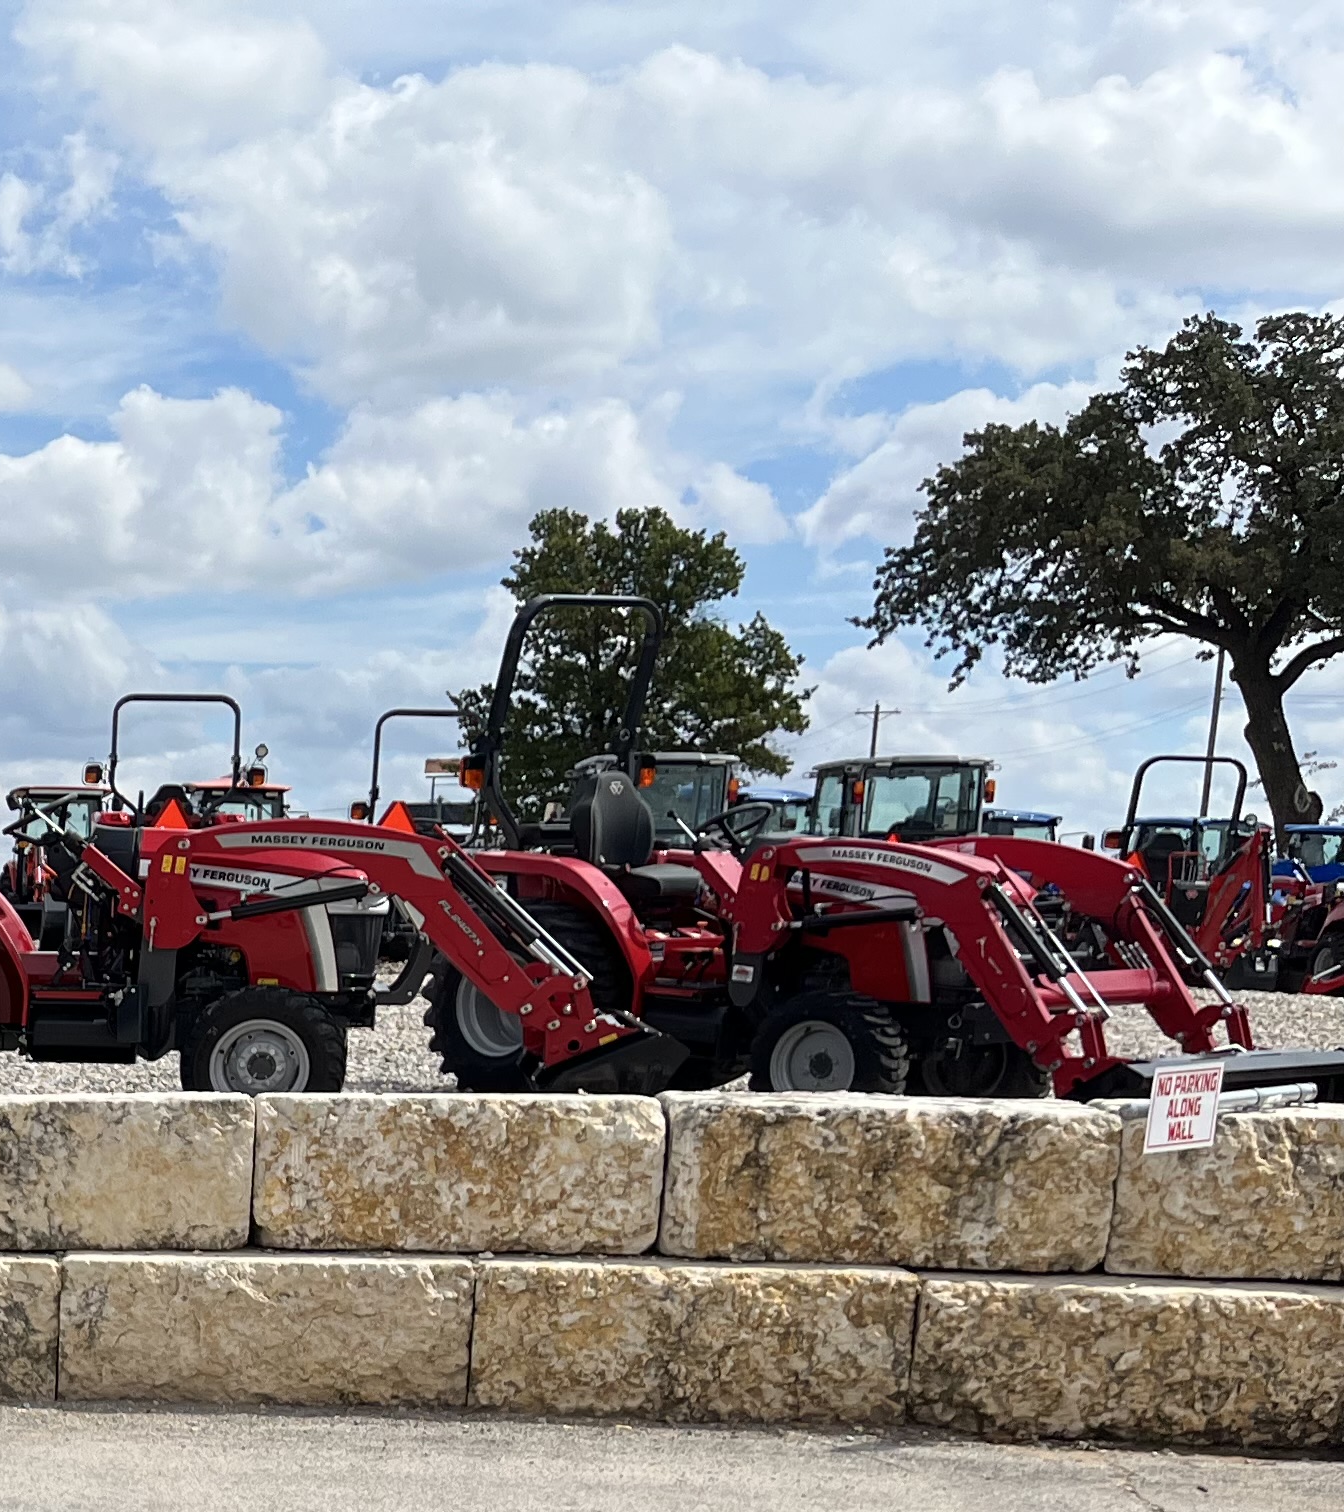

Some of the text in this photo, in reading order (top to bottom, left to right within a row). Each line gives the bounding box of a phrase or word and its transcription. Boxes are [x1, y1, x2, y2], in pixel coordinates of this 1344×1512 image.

[251, 835, 385, 850] MASSEY FERGUSON
[831, 849, 932, 872] MASSEY FERGUSON
[202, 868, 271, 888] FERGUSON
[820, 879, 876, 898] FERGUSON
[1157, 1072, 1218, 1097] NO PARKING
[1166, 1096, 1202, 1119] ALONG
[1167, 1119, 1194, 1142] WALL
